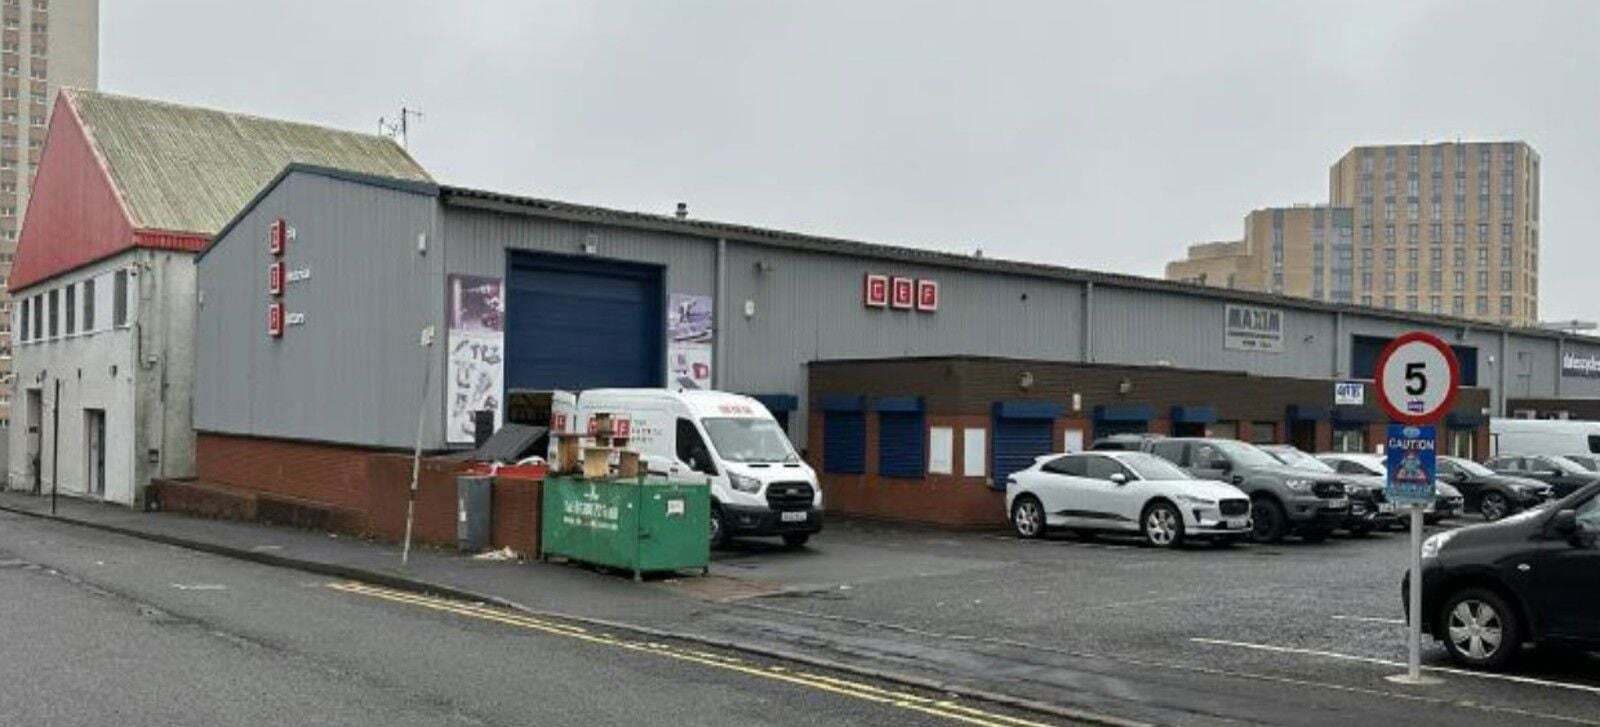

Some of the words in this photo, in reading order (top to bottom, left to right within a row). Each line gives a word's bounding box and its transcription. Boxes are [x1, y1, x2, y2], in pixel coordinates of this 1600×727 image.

[1228, 308, 1280, 332] MAXIM
[1405, 362, 1427, 396] 5
[1388, 438, 1435, 450] CAUTION
